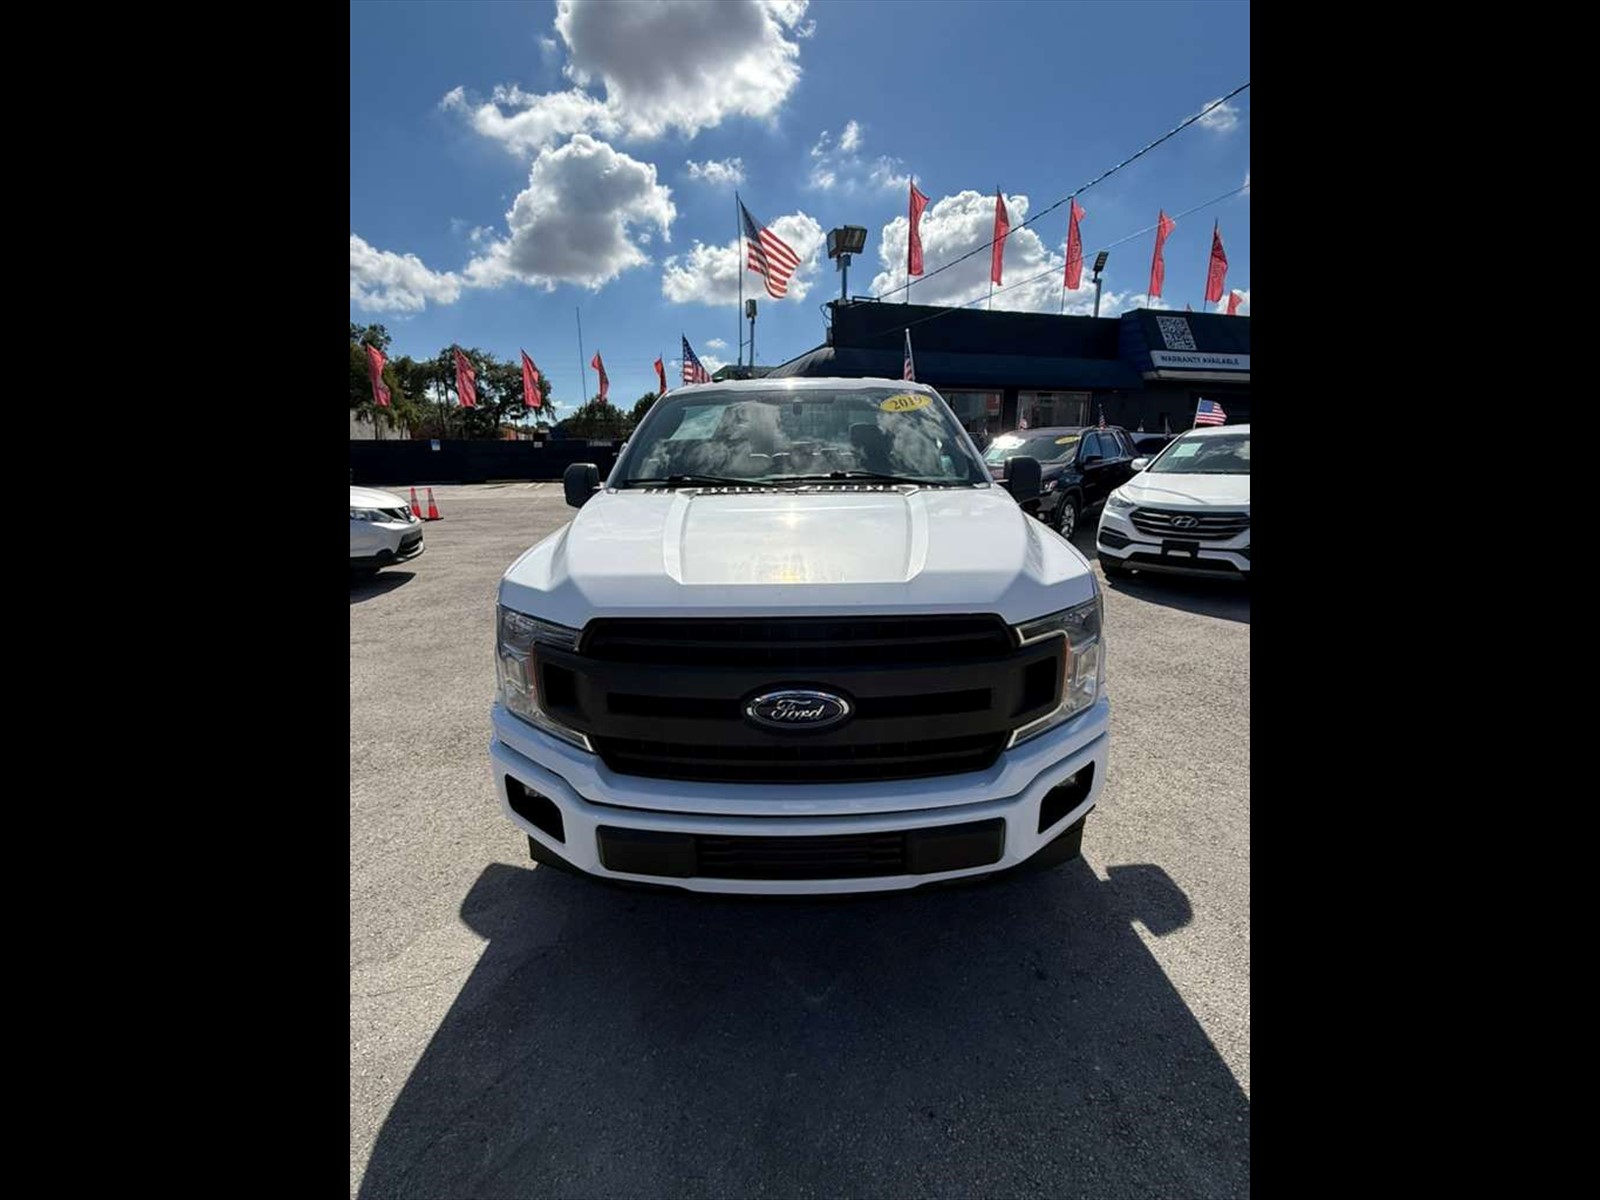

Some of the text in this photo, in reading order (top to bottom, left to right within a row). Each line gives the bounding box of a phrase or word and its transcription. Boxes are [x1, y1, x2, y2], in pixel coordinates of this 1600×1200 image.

[1160, 355, 1240, 366] WARRANTY AVAILABLE
[890, 396, 923, 410] 2019
[771, 699, 825, 719] Ford
